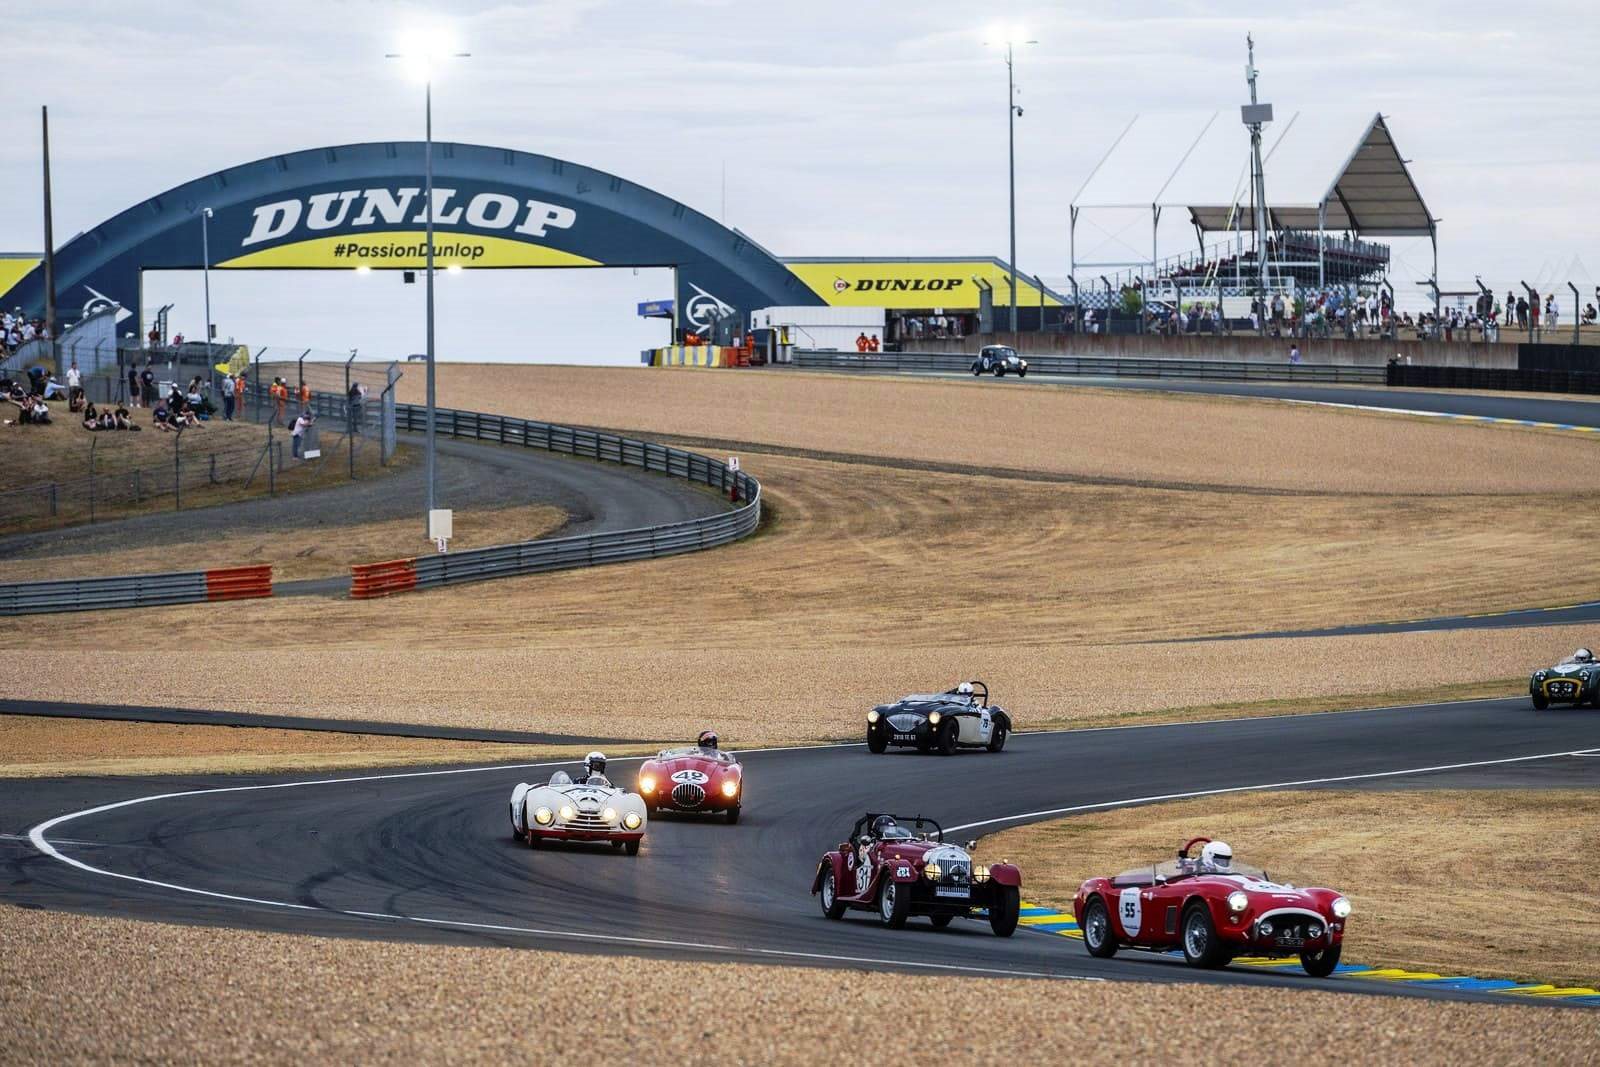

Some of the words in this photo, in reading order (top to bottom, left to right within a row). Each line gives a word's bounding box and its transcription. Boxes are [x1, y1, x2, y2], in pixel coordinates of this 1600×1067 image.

[241, 187, 577, 247] DUNLOP
[334, 243, 485, 259] #PassionDunlop
[854, 279, 963, 291] DUNLOP
[1125, 902, 1136, 919] 55
